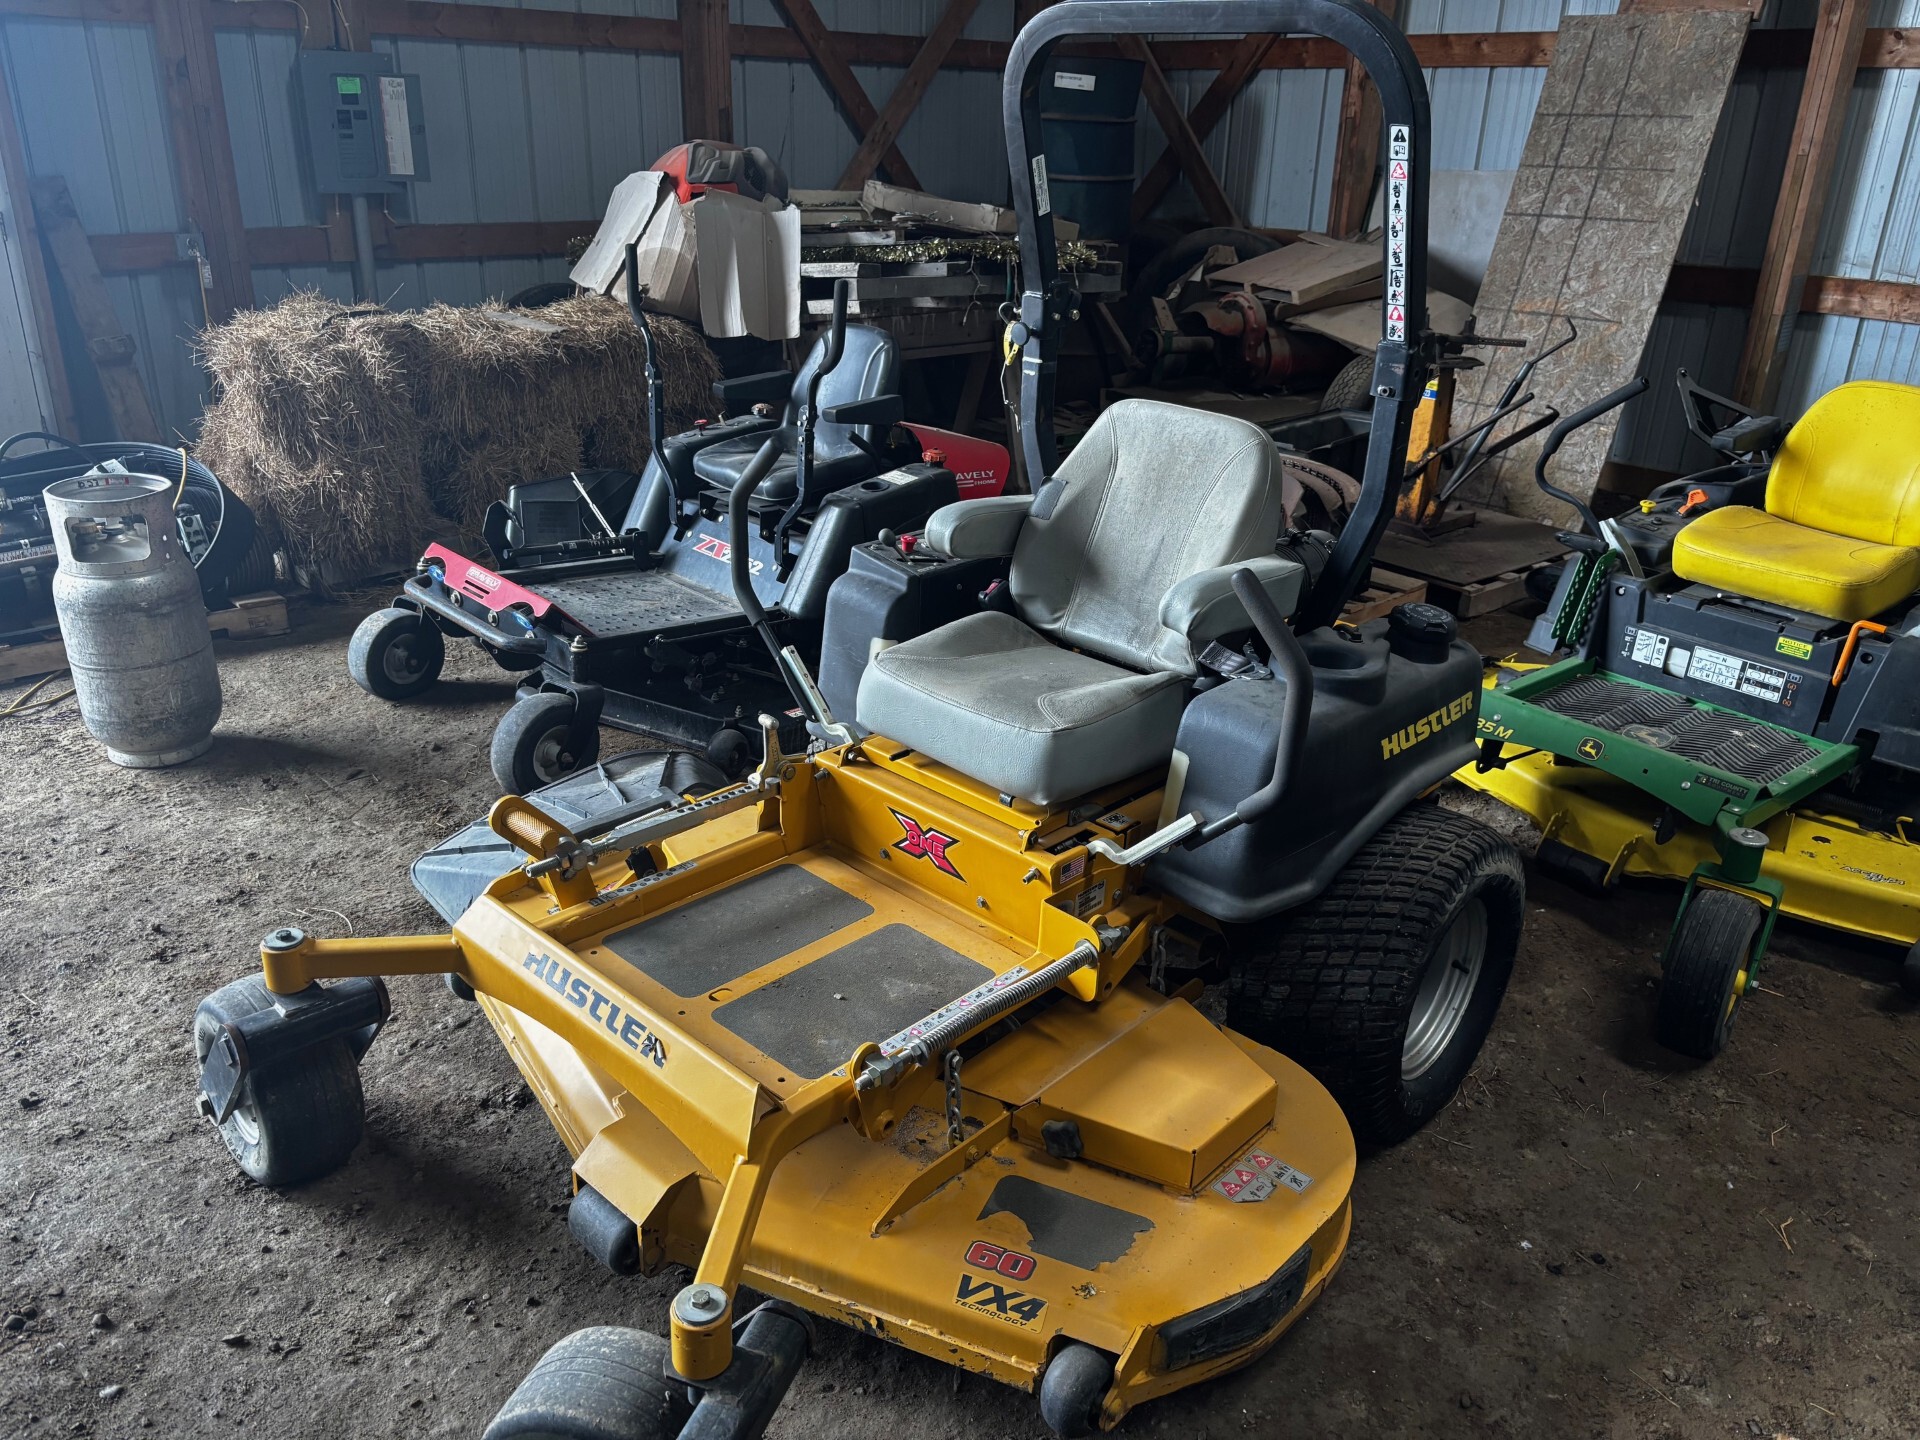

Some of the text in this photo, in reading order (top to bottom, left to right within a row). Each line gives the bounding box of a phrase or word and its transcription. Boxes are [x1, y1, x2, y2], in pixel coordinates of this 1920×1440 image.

[1381, 690, 1473, 760] HUSTLER
[1721, 780, 1749, 794] COUNTY
[907, 830, 945, 859] ONE
[963, 1240, 1037, 1281] 60
[954, 1298, 1028, 1328] TECHNOLOGY
[956, 1273, 1048, 1322] VX4
